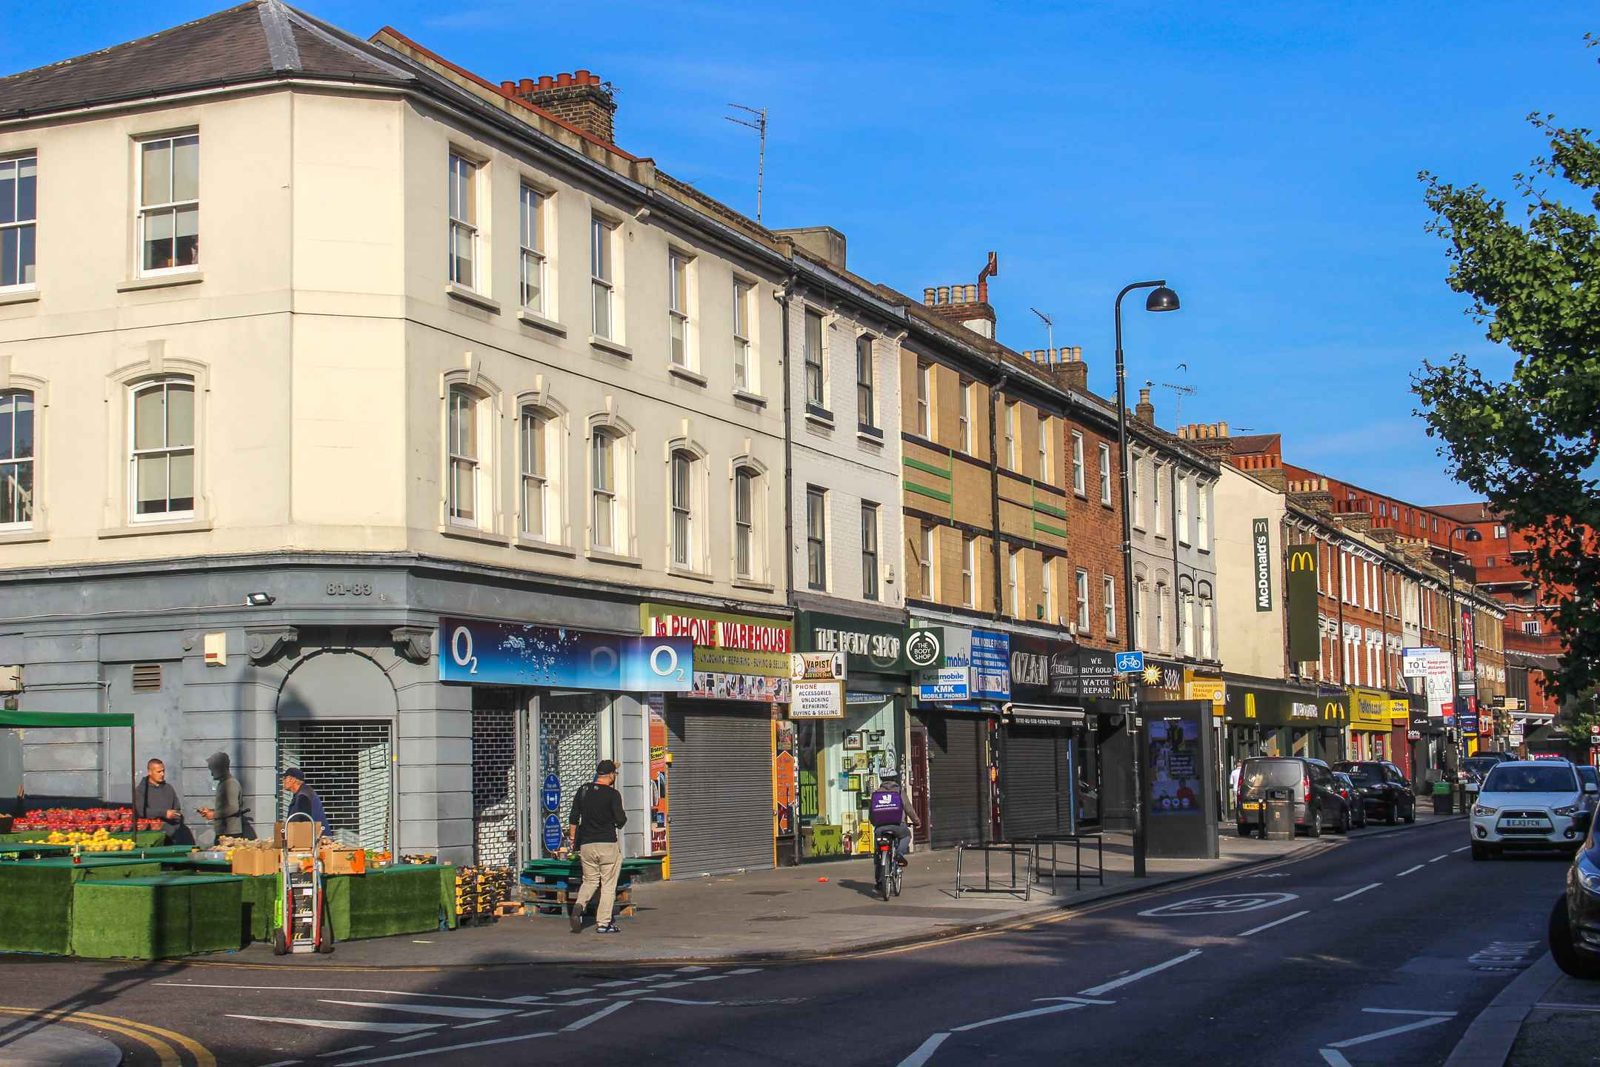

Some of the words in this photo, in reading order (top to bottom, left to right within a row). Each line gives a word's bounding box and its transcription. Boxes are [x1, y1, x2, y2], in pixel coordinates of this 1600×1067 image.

[1257, 536, 1269, 608] McDonald's
[327, 583, 372, 596] 81-83
[721, 621, 791, 654] WAREHOUSE
[815, 628, 839, 651] THE
[839, 630, 869, 656] BODY
[871, 633, 900, 660] SHOP
[650, 645, 685, 682] O2
[806, 660, 830, 669] VAPIST
[933, 685, 955, 693] KMK
[651, 840, 667, 851] REPAIR
